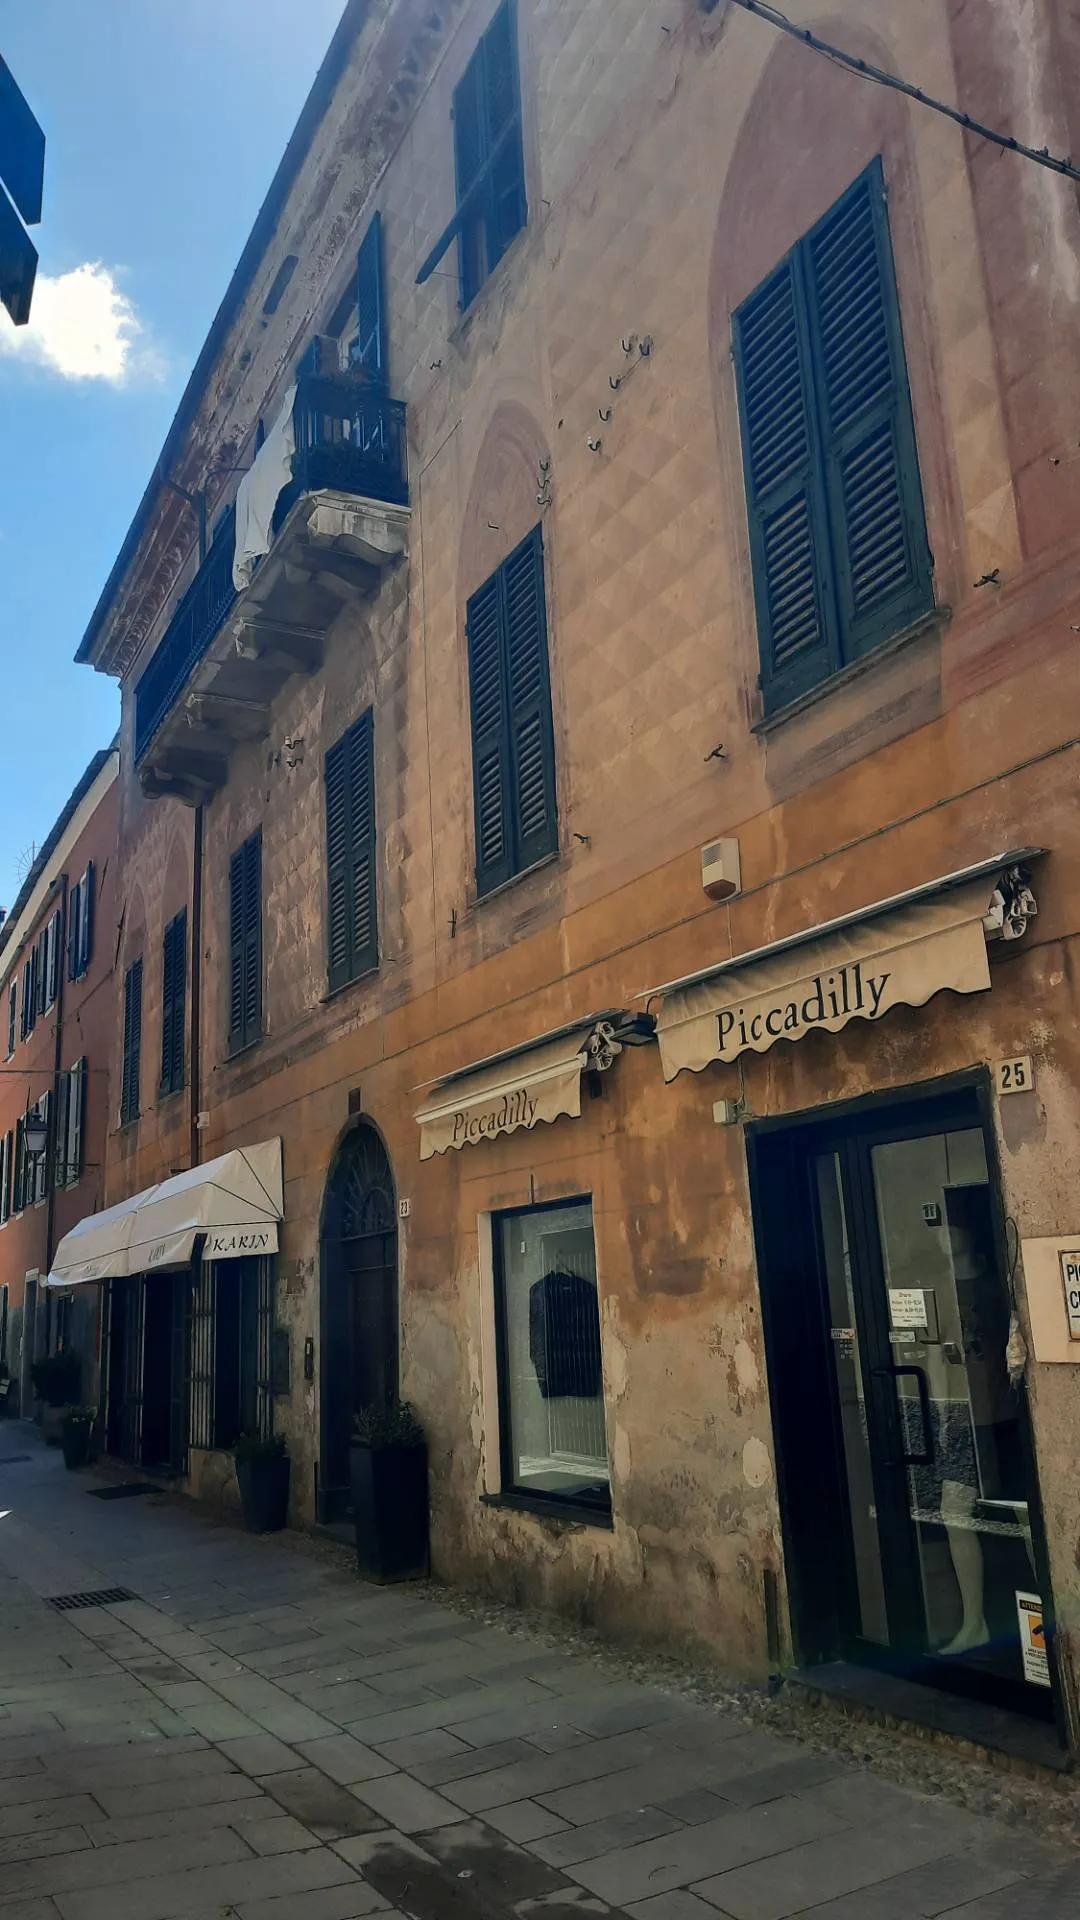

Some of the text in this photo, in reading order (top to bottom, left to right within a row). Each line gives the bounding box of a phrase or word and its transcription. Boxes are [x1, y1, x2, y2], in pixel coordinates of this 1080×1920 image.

[714, 963, 891, 1051] Piccadilly
[1001, 1062, 1025, 1089] 25
[452, 1089, 539, 1142] Piccadilly
[400, 1201, 408, 1215] 23
[212, 1233, 269, 1252] KARIN
[1066, 1263, 1080, 1282] PI
